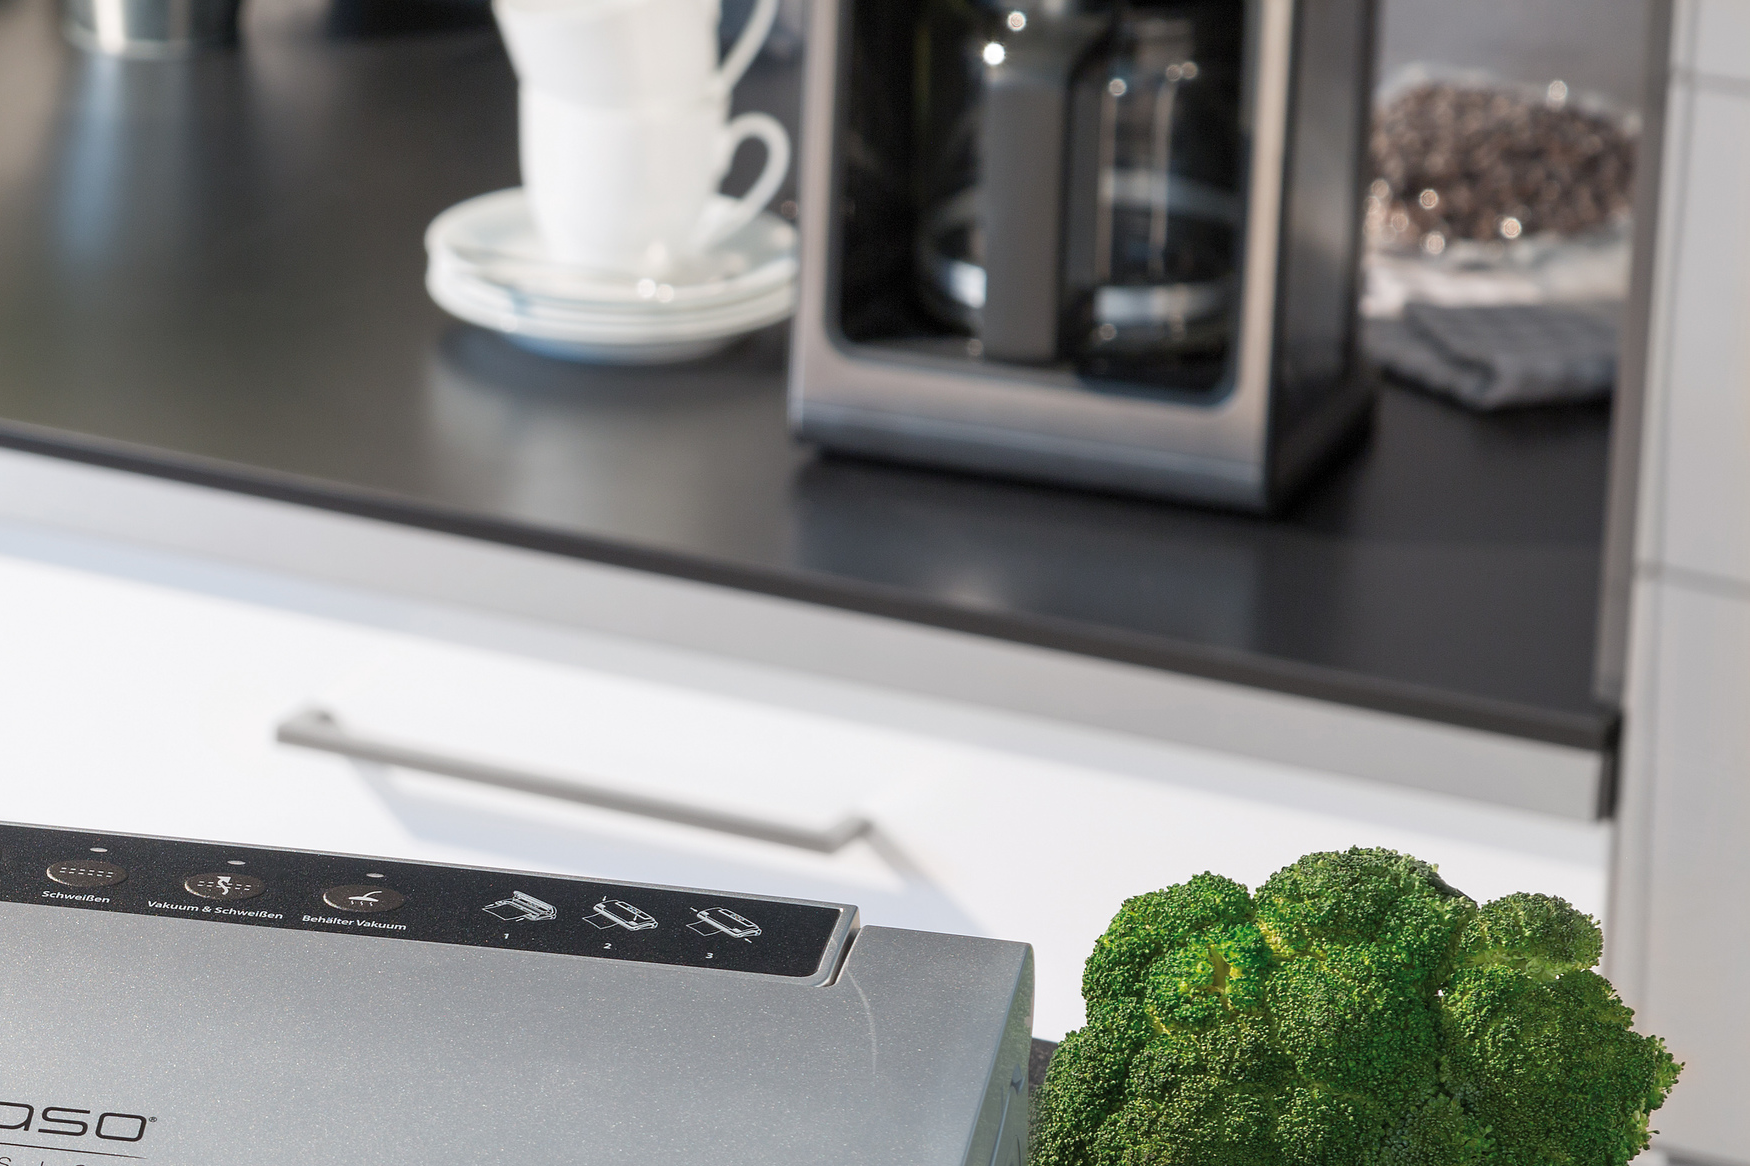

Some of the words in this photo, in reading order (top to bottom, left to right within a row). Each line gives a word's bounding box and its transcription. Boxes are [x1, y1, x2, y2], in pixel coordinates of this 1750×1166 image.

[41, 890, 111, 904] Schweißen
[148, 900, 199, 912] Vakuum
[201, 905, 213, 913] &
[214, 906, 284, 920] Schweißen
[302, 914, 354, 926] Behälter
[356, 919, 407, 931] Vakuum
[603, 942, 613, 950] 2
